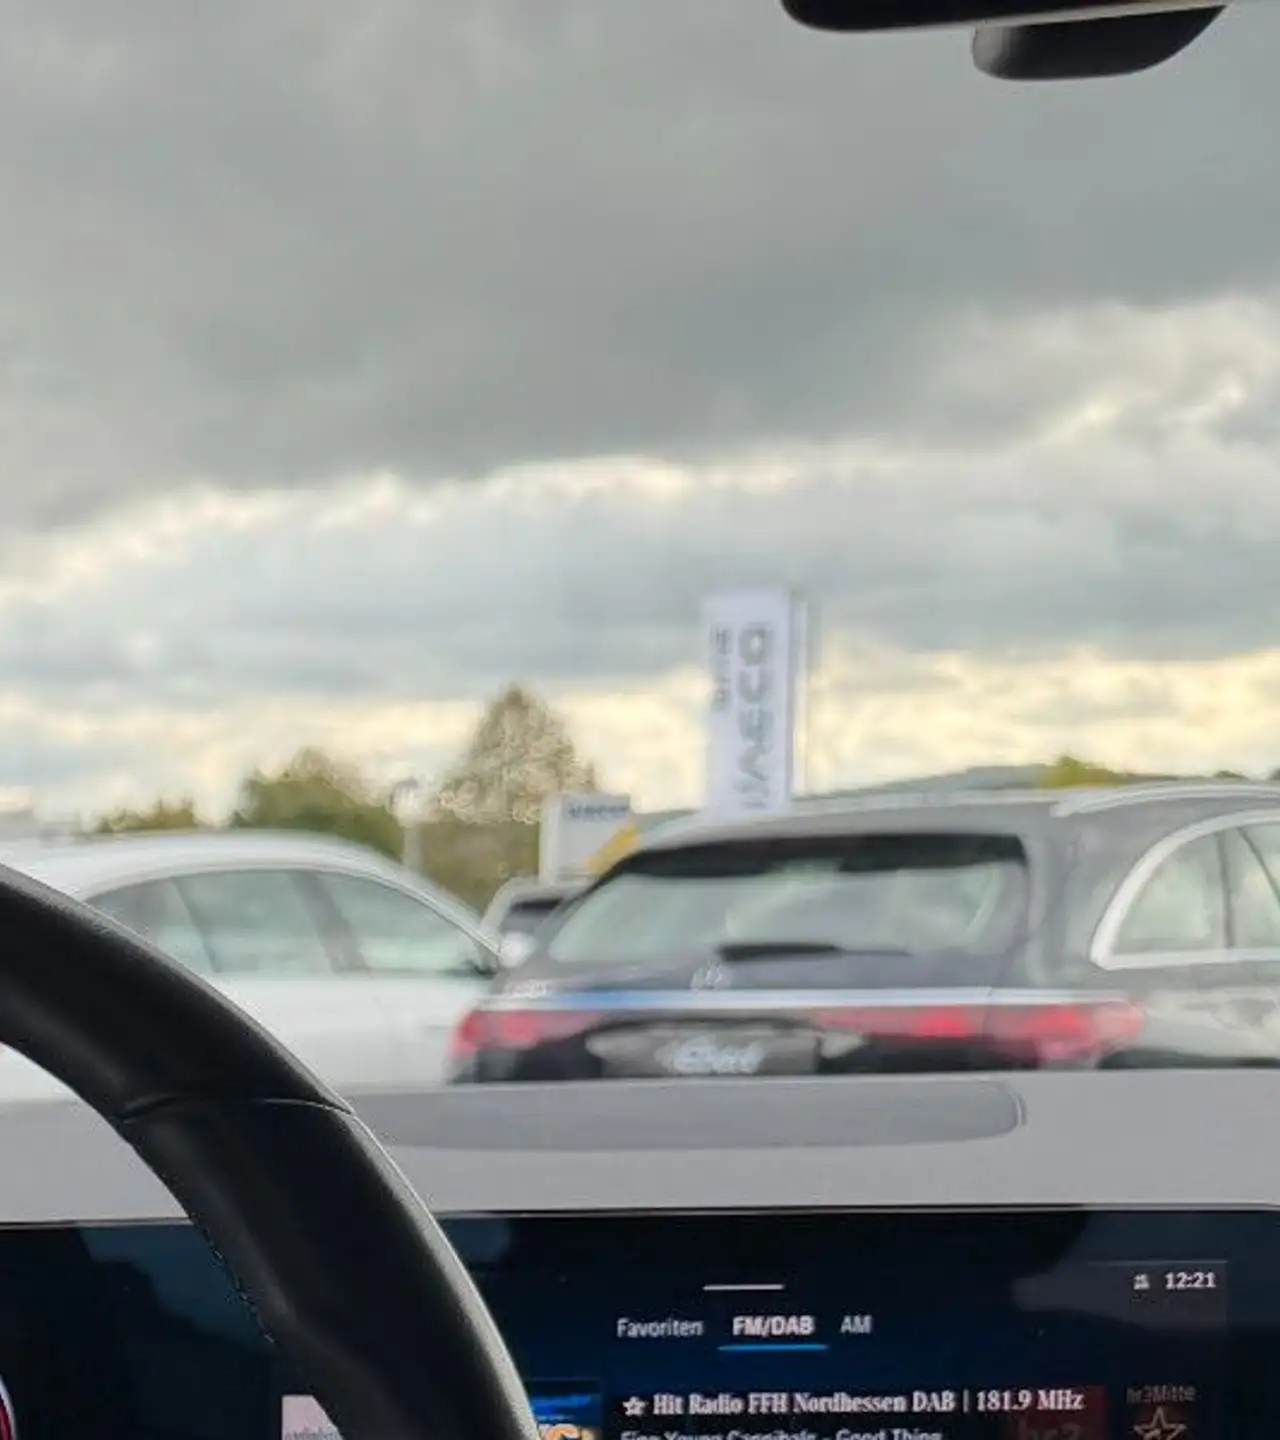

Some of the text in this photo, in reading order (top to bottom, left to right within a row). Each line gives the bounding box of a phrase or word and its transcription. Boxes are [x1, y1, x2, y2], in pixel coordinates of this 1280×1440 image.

[1165, 1272, 1216, 1289] 12:21
[617, 1318, 704, 1338] Favoriten
[733, 1315, 815, 1337] FM/DAB
[841, 1315, 872, 1334] AM
[653, 1393, 684, 1415] Hit
[689, 1392, 743, 1415] Radio
[748, 1392, 788, 1414] FFH
[793, 1390, 907, 1413] Nordhessen
[912, 1390, 956, 1412] DAB
[977, 1389, 1032, 1412] 181.9
[1037, 1389, 1085, 1412] MHz
